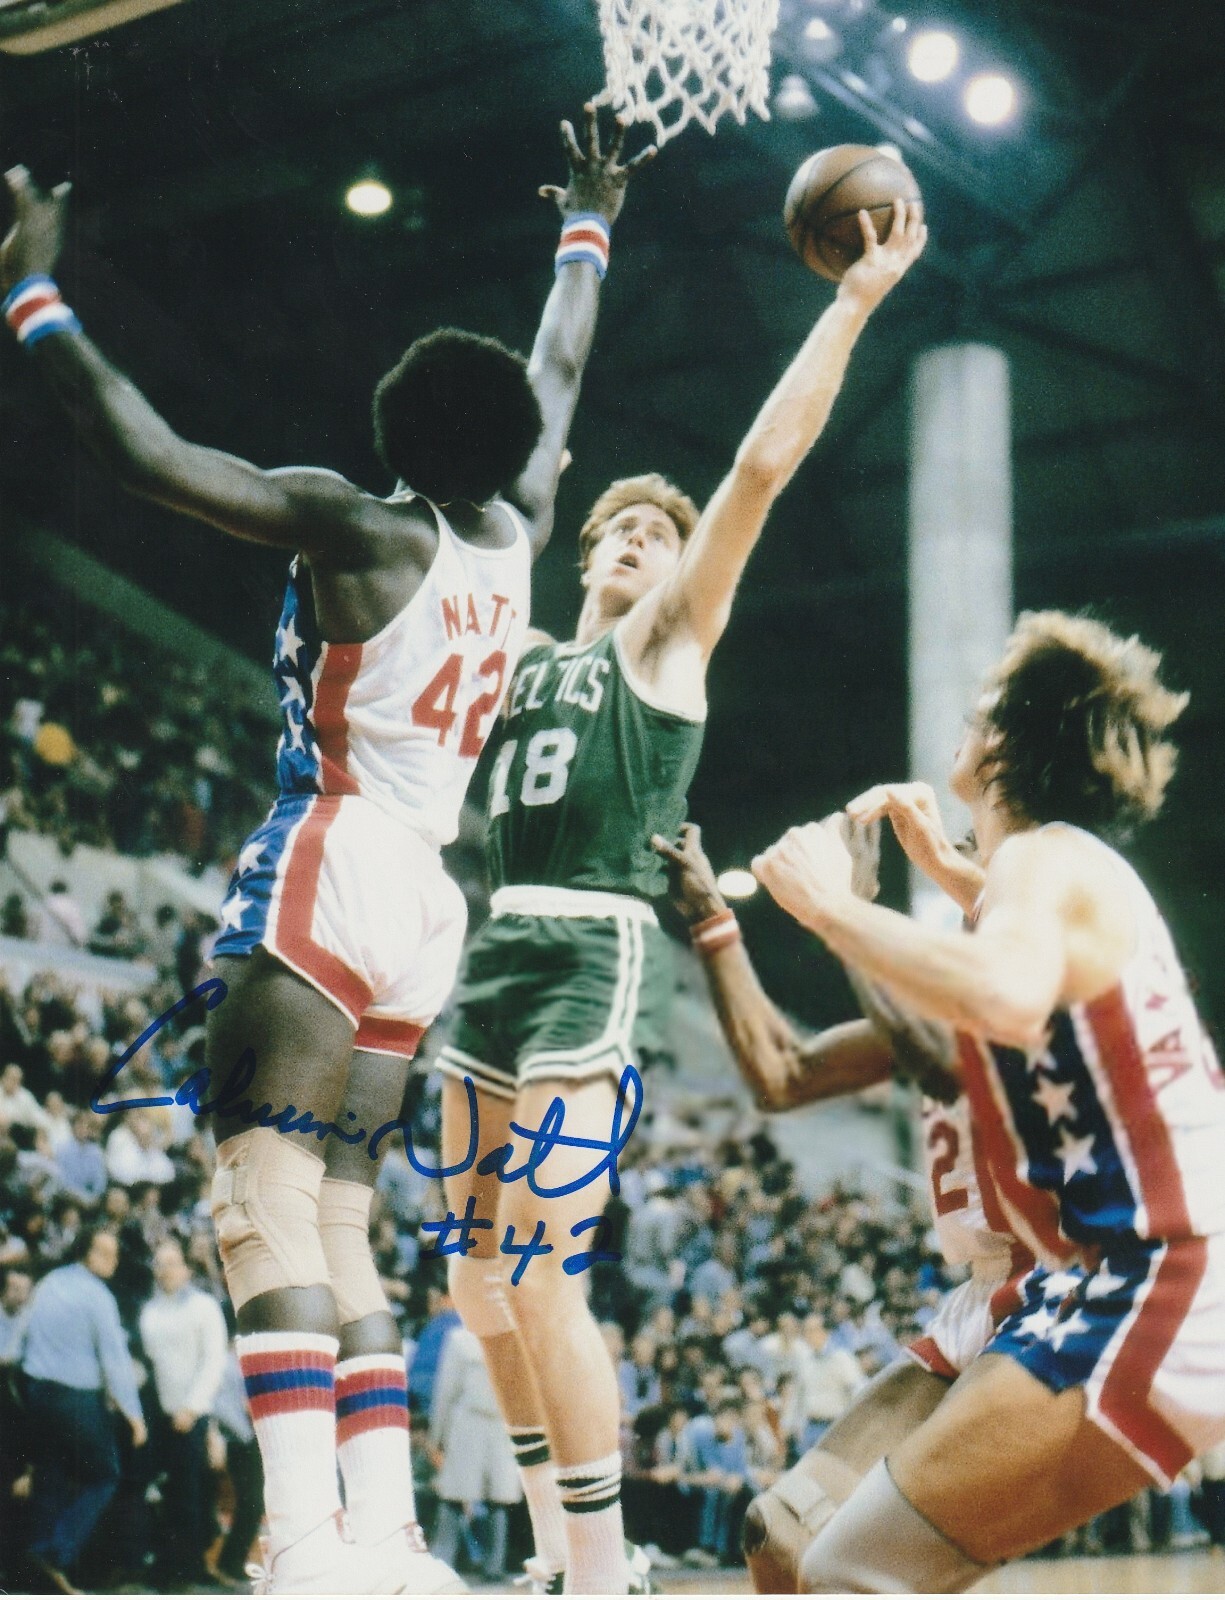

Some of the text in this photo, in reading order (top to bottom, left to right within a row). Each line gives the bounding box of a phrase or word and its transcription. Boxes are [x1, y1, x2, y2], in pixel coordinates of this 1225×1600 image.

[441, 592, 517, 650] NAT
[411, 650, 507, 759] 42
[488, 727, 578, 819] 18
[418, 1195, 623, 1286] #42
